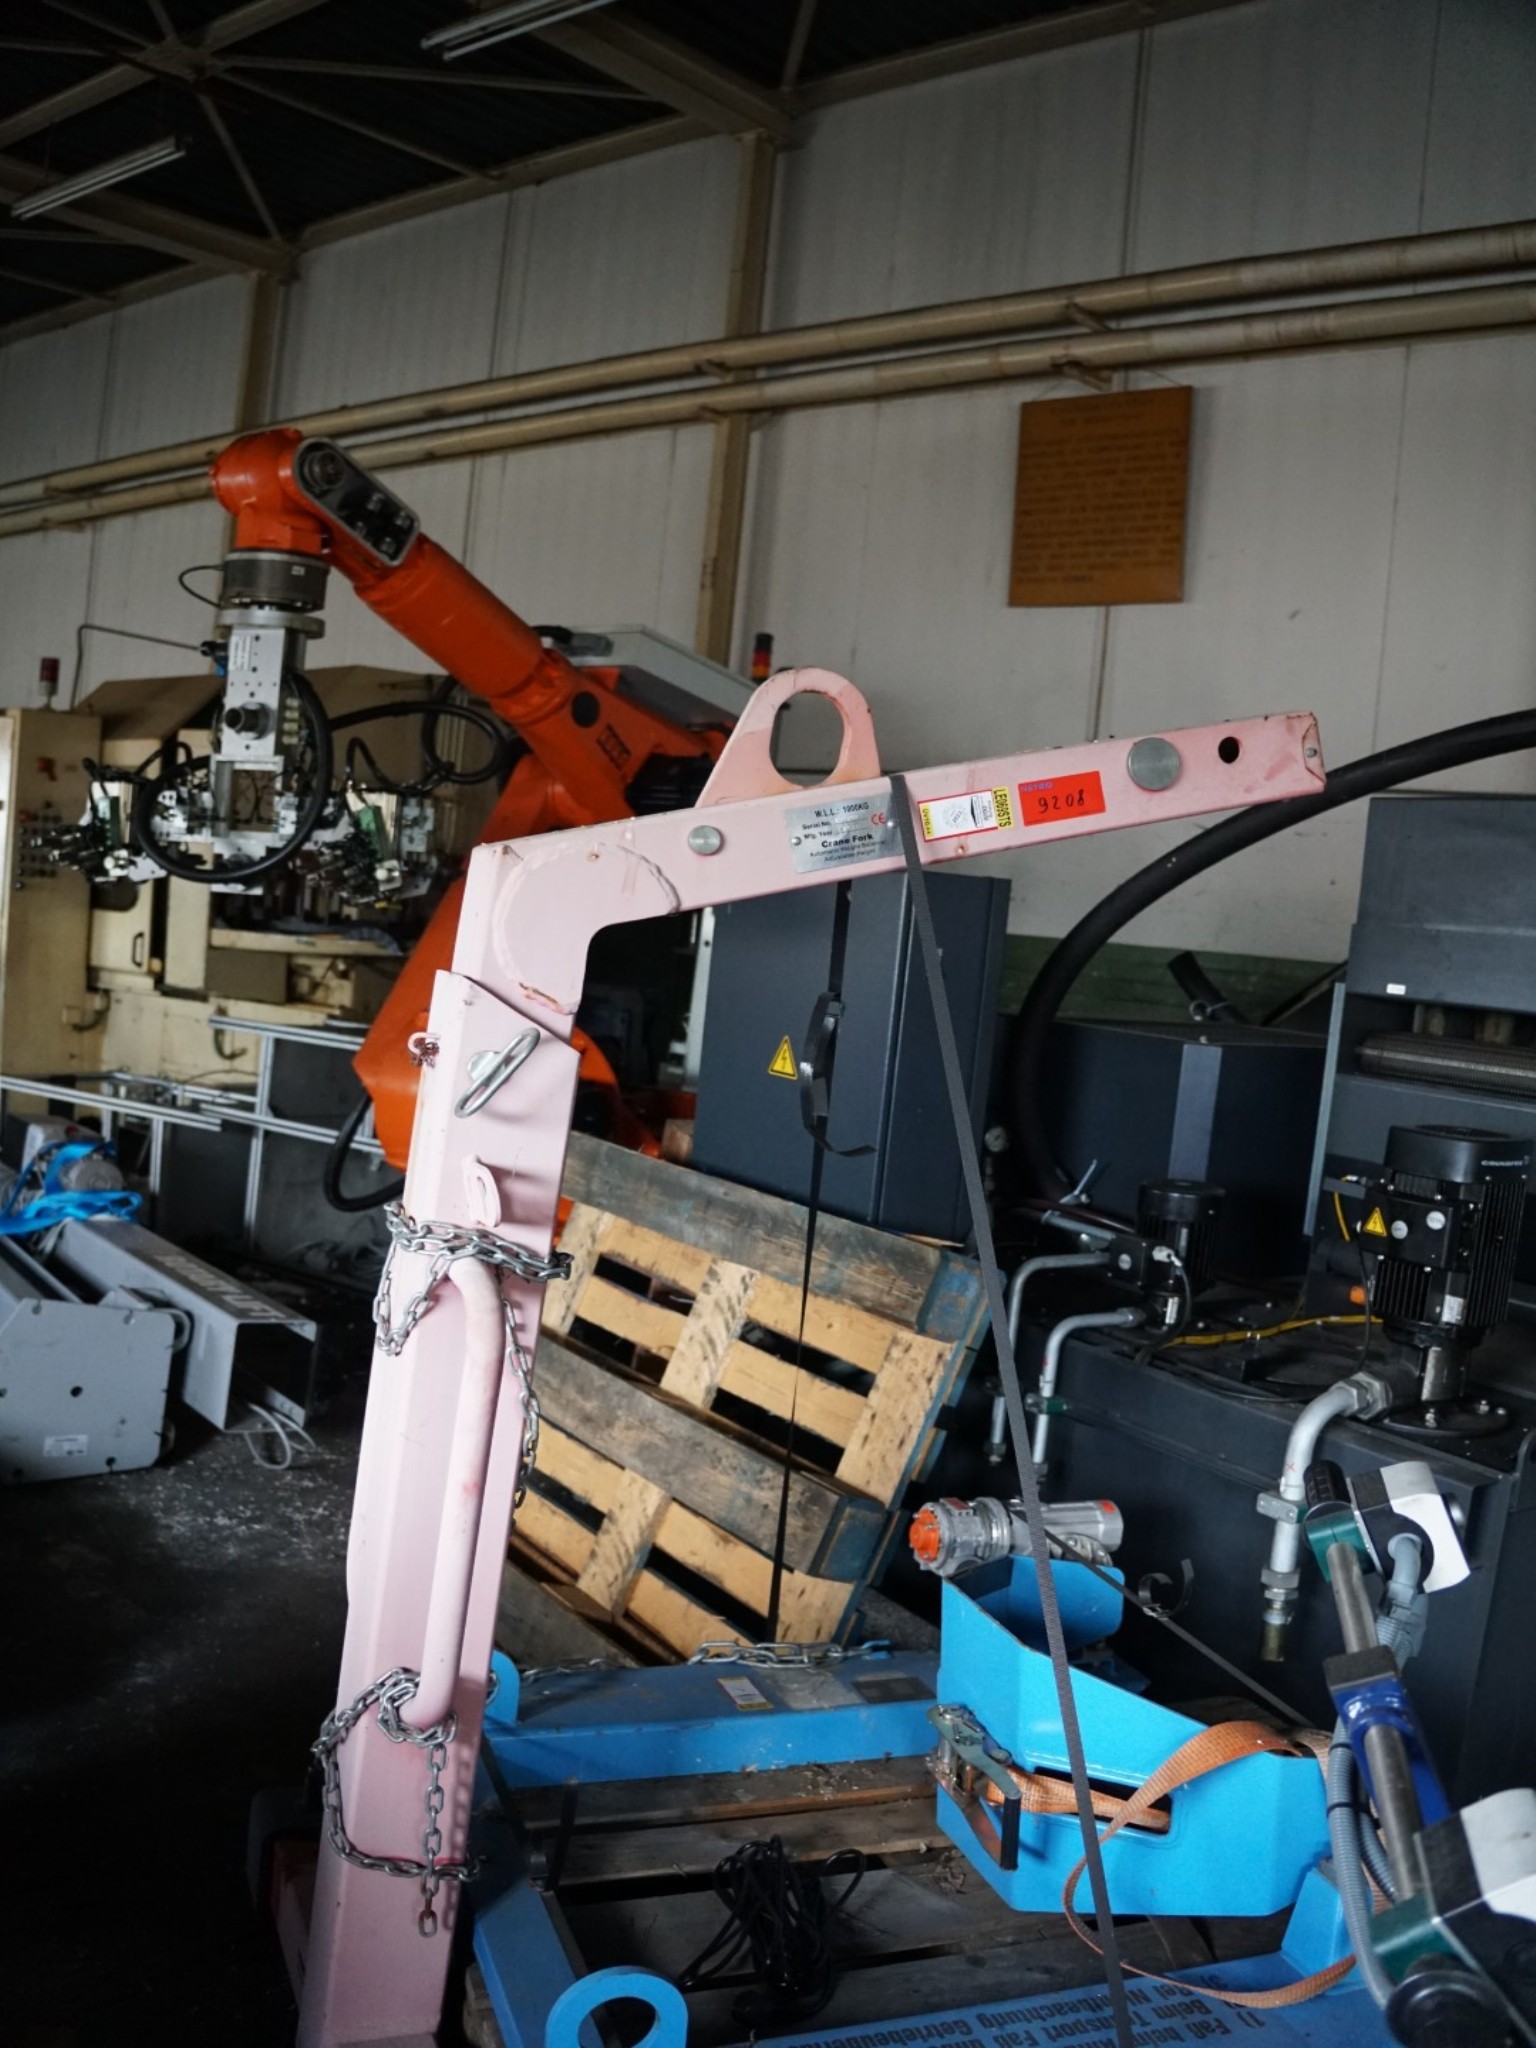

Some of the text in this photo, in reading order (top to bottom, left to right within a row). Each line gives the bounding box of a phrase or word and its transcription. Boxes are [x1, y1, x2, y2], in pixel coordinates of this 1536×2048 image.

[1038, 789, 1085, 813] 9208
[821, 833, 874, 848] Crane Fork
[1152, 1999, 1213, 2020] Beim
